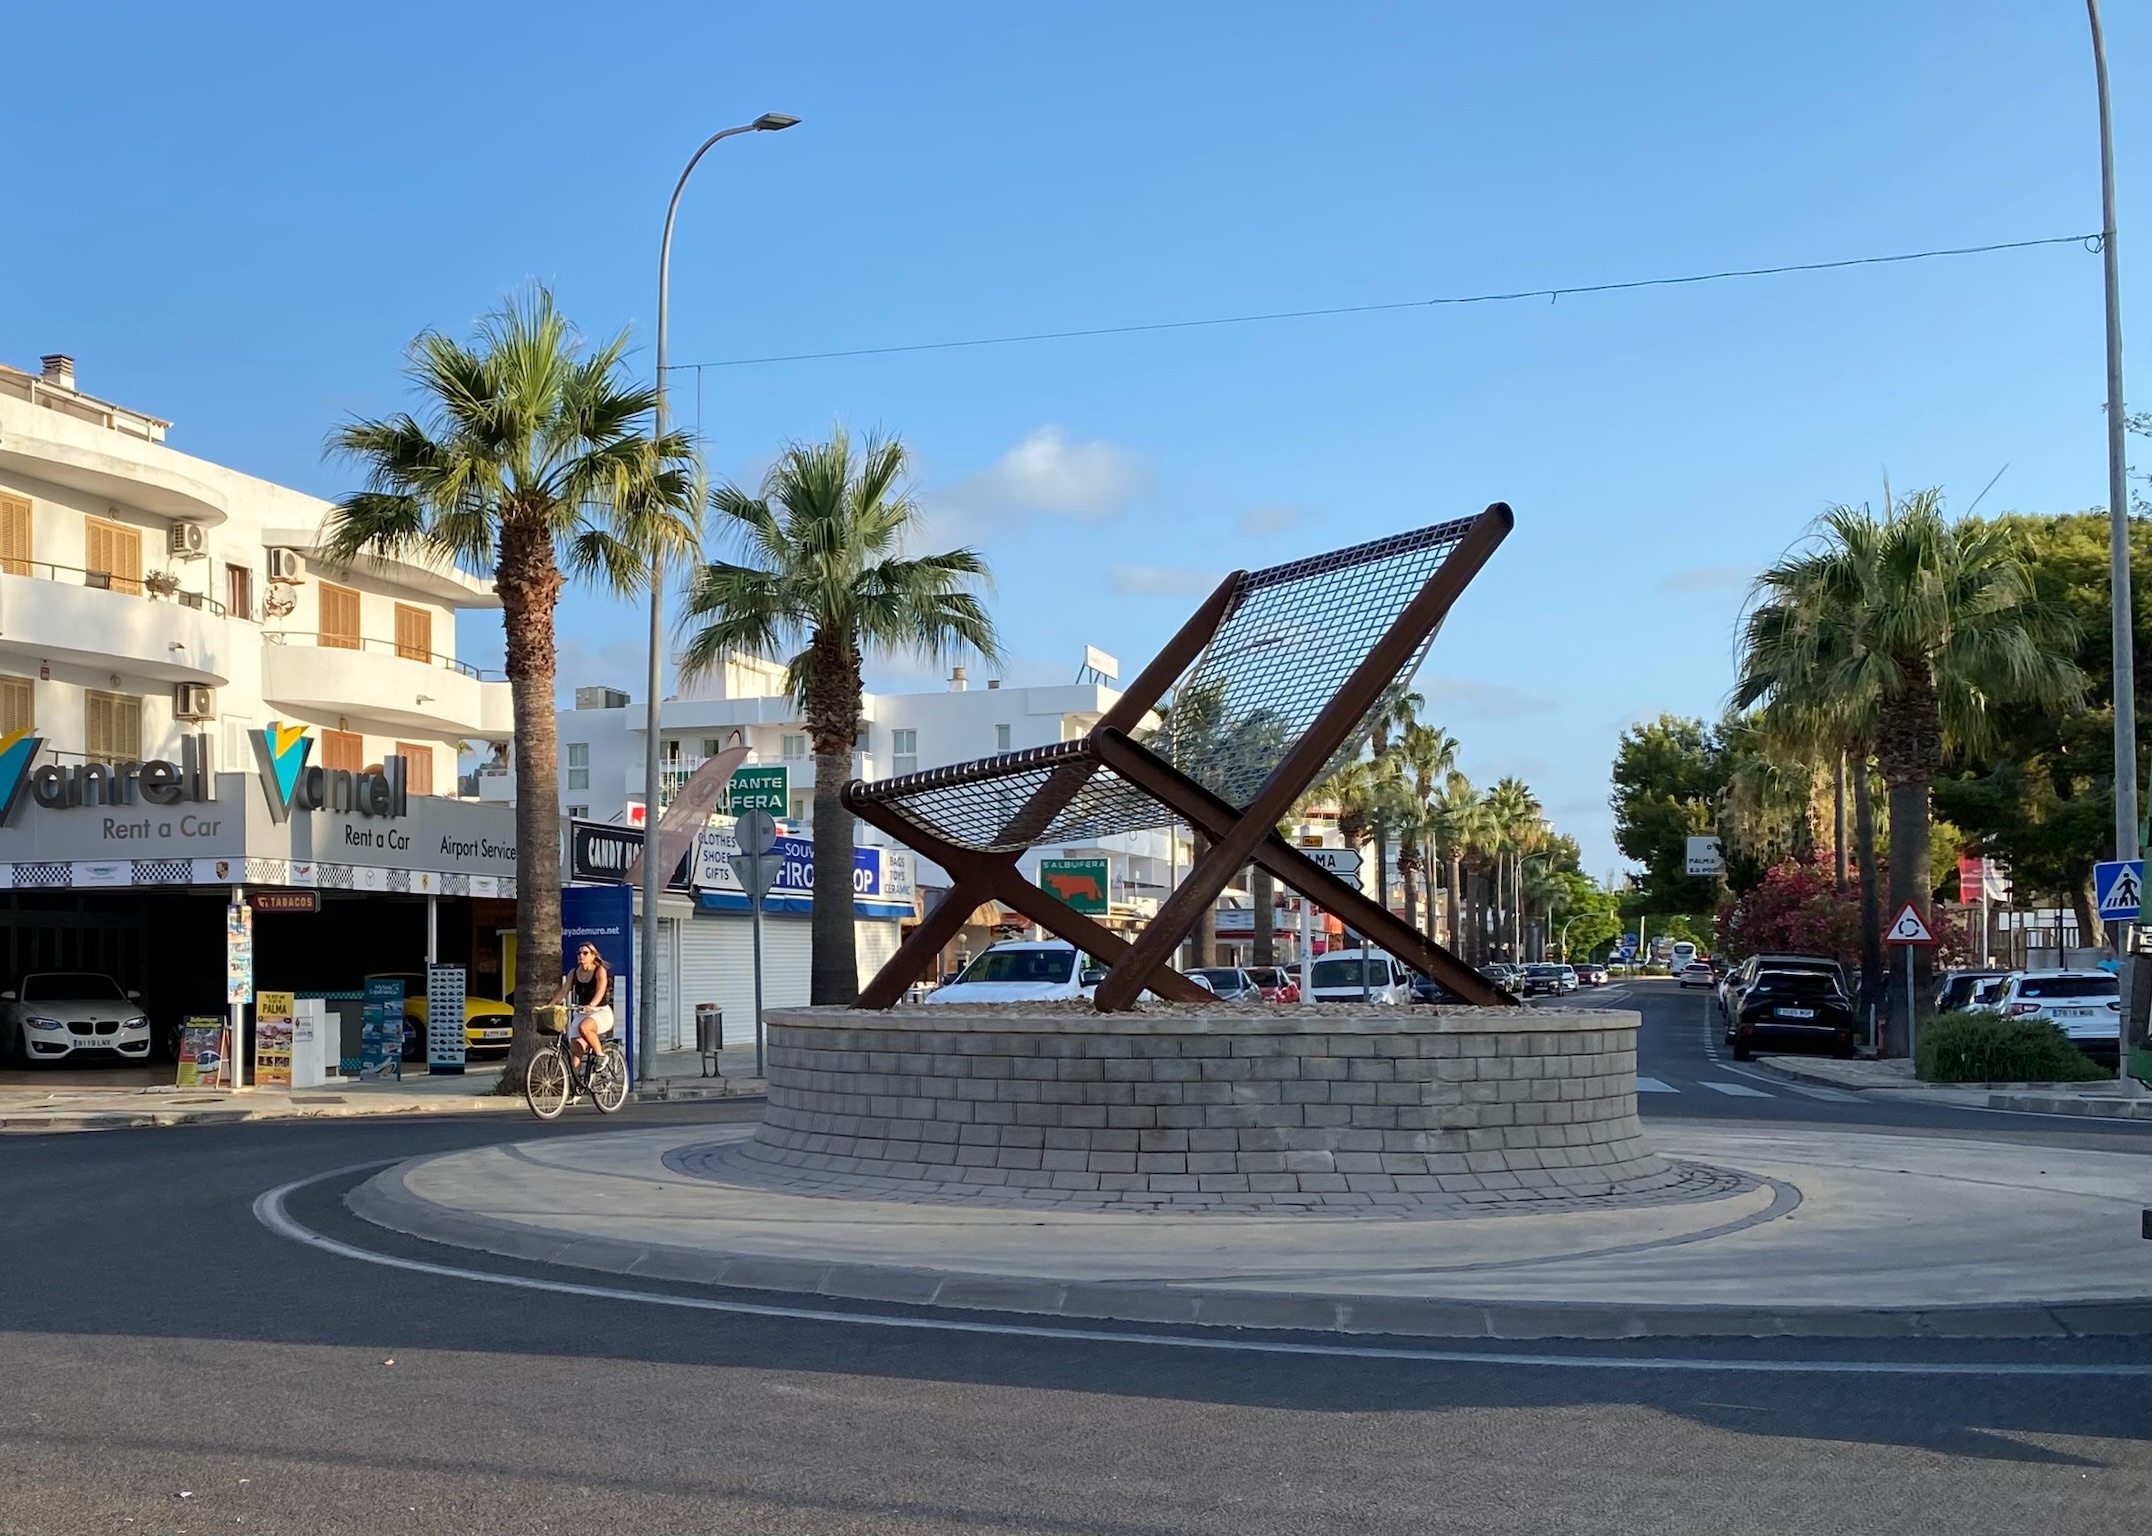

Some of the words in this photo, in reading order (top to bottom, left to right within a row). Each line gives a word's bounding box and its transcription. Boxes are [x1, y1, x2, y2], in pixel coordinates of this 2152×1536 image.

[729, 777, 782, 789] RANTE
[718, 795, 782, 808] UFERA
[103, 817, 151, 840] Rent
[158, 822, 171, 838] a
[180, 815, 222, 838] Car
[345, 825, 372, 847] Rent
[376, 834, 384, 848] a
[388, 829, 410, 850] Car
[698, 832, 736, 848] CLOTHES
[440, 835, 478, 860] Airport
[588, 836, 623, 870] CANDY
[625, 841, 644, 871] HO
[785, 842, 814, 858] SOUV
[703, 850, 731, 864] SHOES
[889, 856, 905, 868] BAGS
[1308, 853, 1336, 868] MA
[705, 867, 729, 880] GIFTS
[774, 861, 814, 888] FIRO
[853, 868, 873, 892] OP
[889, 870, 905, 881] TOYS
[270, 896, 313, 908] TABACOS
[562, 926, 620, 937] layademuro.net
[262, 1003, 287, 1015] PALMA
